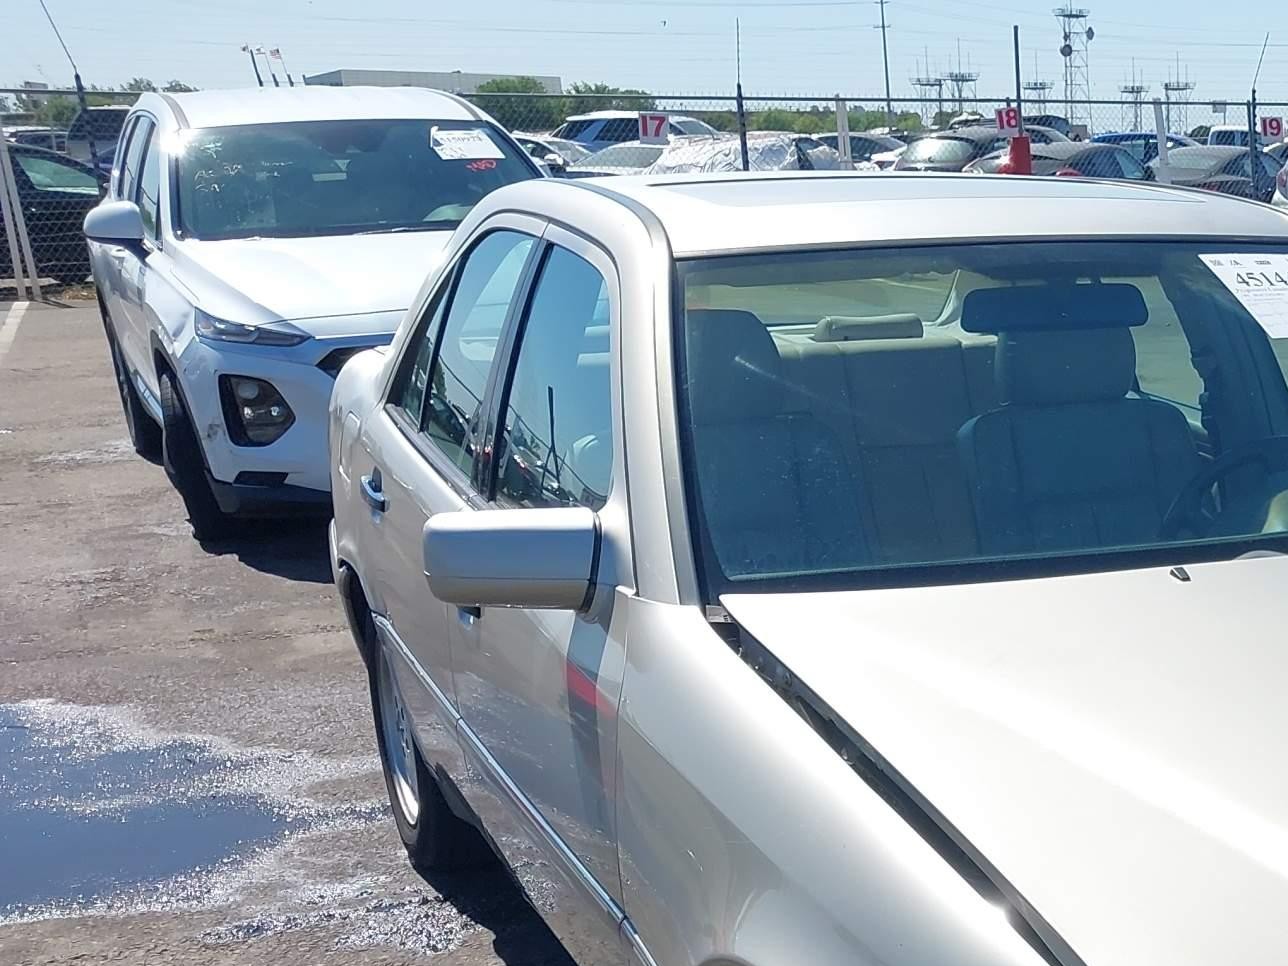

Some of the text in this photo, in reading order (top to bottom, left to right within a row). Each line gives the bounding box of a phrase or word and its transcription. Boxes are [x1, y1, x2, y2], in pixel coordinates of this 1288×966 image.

[641, 115, 666, 137] 17
[998, 110, 1018, 129] 18
[1262, 118, 1281, 136] 19
